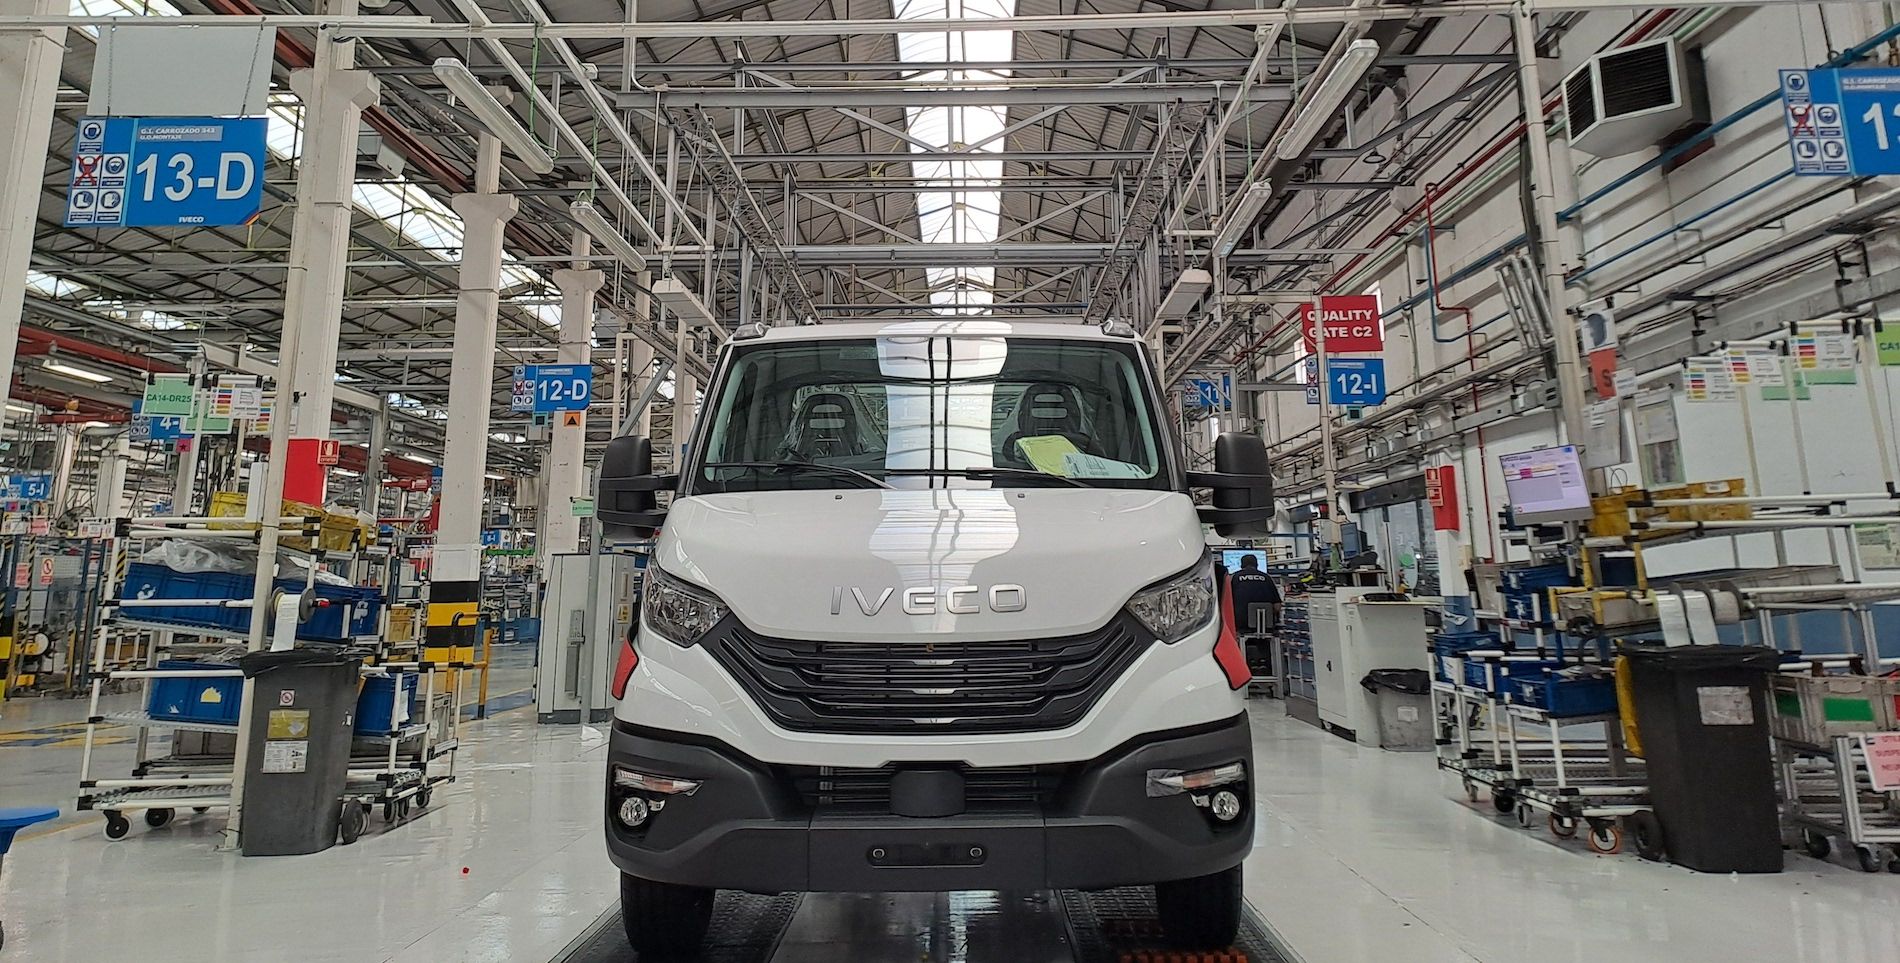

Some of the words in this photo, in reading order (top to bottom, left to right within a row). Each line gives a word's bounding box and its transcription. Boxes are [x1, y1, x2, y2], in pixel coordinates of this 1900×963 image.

[155, 127, 200, 135] CARROZADO
[1863, 103, 1900, 150] 1
[136, 152, 255, 202] 13-D
[1352, 326, 1373, 338] C2
[538, 378, 588, 401] 12-D
[1336, 373, 1378, 395] 12-I
[146, 393, 192, 403] CA14-DR25
[28, 482, 45, 497] 5-I
[1238, 574, 1266, 582] IVECO
[831, 584, 1027, 617] IVECO
